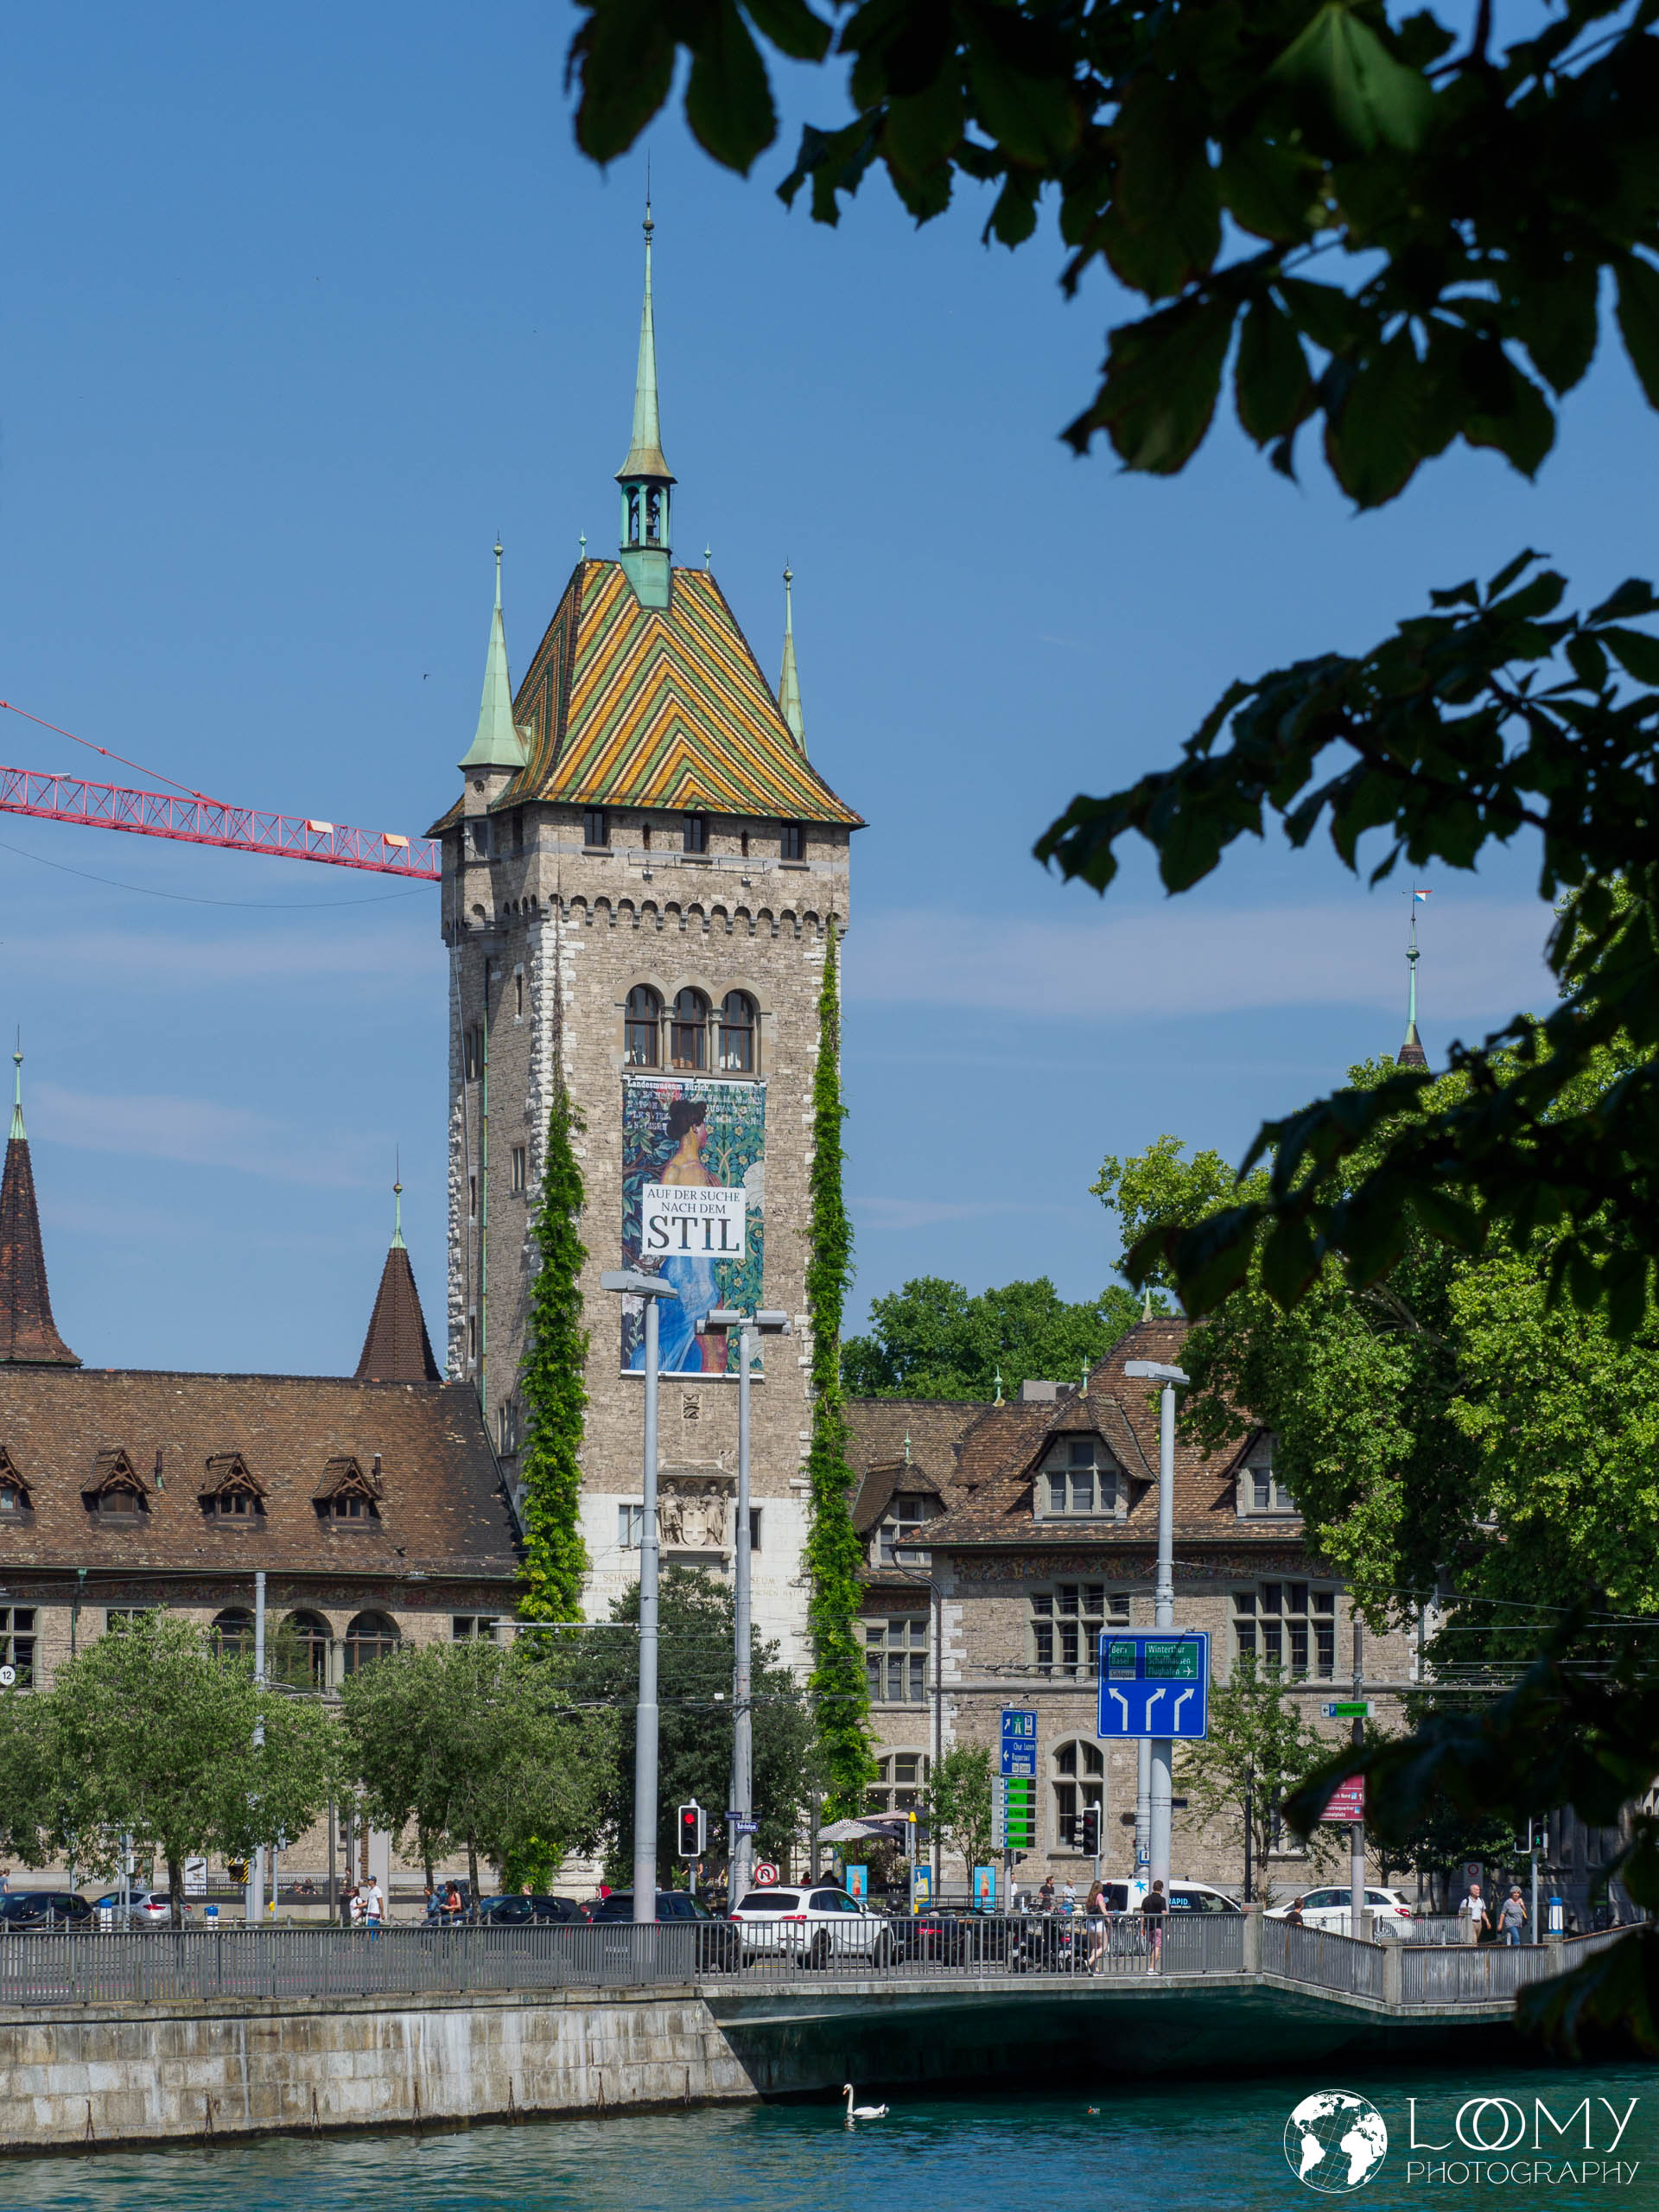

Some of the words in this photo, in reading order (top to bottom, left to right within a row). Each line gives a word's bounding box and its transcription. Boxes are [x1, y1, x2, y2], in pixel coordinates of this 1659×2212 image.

[627, 1079, 683, 1090] Landesmuseum
[647, 1188, 671, 1199] AUF
[674, 1189, 697, 1200] DER
[700, 1192, 741, 1202] SUCHE
[661, 1202, 696, 1213] NACH
[700, 1204, 727, 1214] DEM
[647, 1215, 740, 1252] STIL
[1111, 1645, 1128, 1654] Bern
[1148, 1645, 1185, 1654] Winterthur
[1148, 1656, 1191, 1666] Schaffhausen
[3, 1670, 12, 1680] 12
